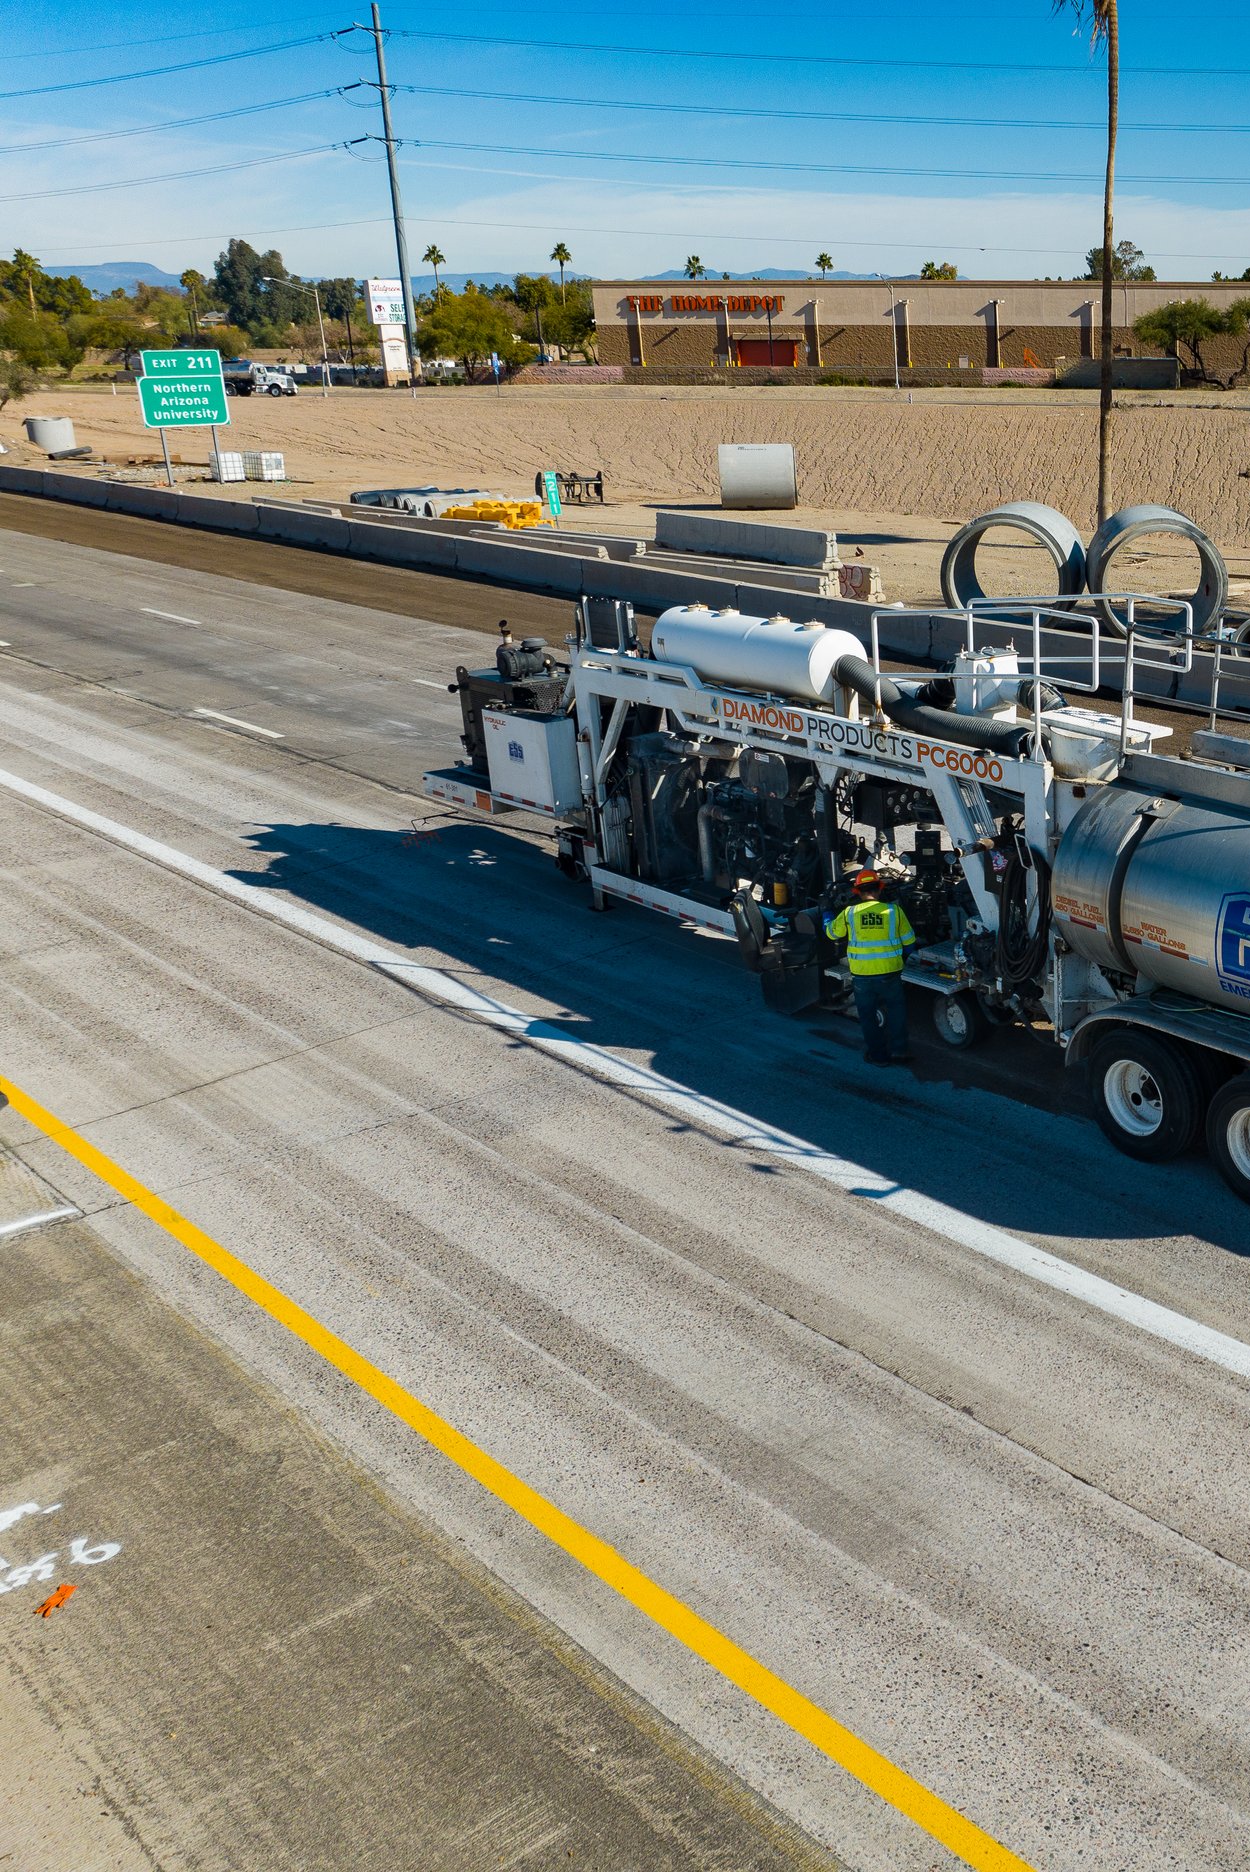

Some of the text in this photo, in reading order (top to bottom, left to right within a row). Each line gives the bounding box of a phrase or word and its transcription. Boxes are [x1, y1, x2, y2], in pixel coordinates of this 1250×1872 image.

[626, 295, 785, 312] THE HOME DEPOT
[152, 356, 212, 368] EXIT 211
[153, 383, 211, 393] Northern
[161, 396, 209, 406] Arizona
[153, 408, 218, 420] University
[547, 481, 558, 514] 211
[722, 699, 1003, 783] DIAMOND PRODUCTS PC6000
[1055, 895, 1102, 915] DIESEL FUEL
[861, 913, 883, 926] ESS
[1070, 907, 1105, 924] GALLONS
[1140, 921, 1167, 937] WATER
[1147, 931, 1186, 951] GALLONS
